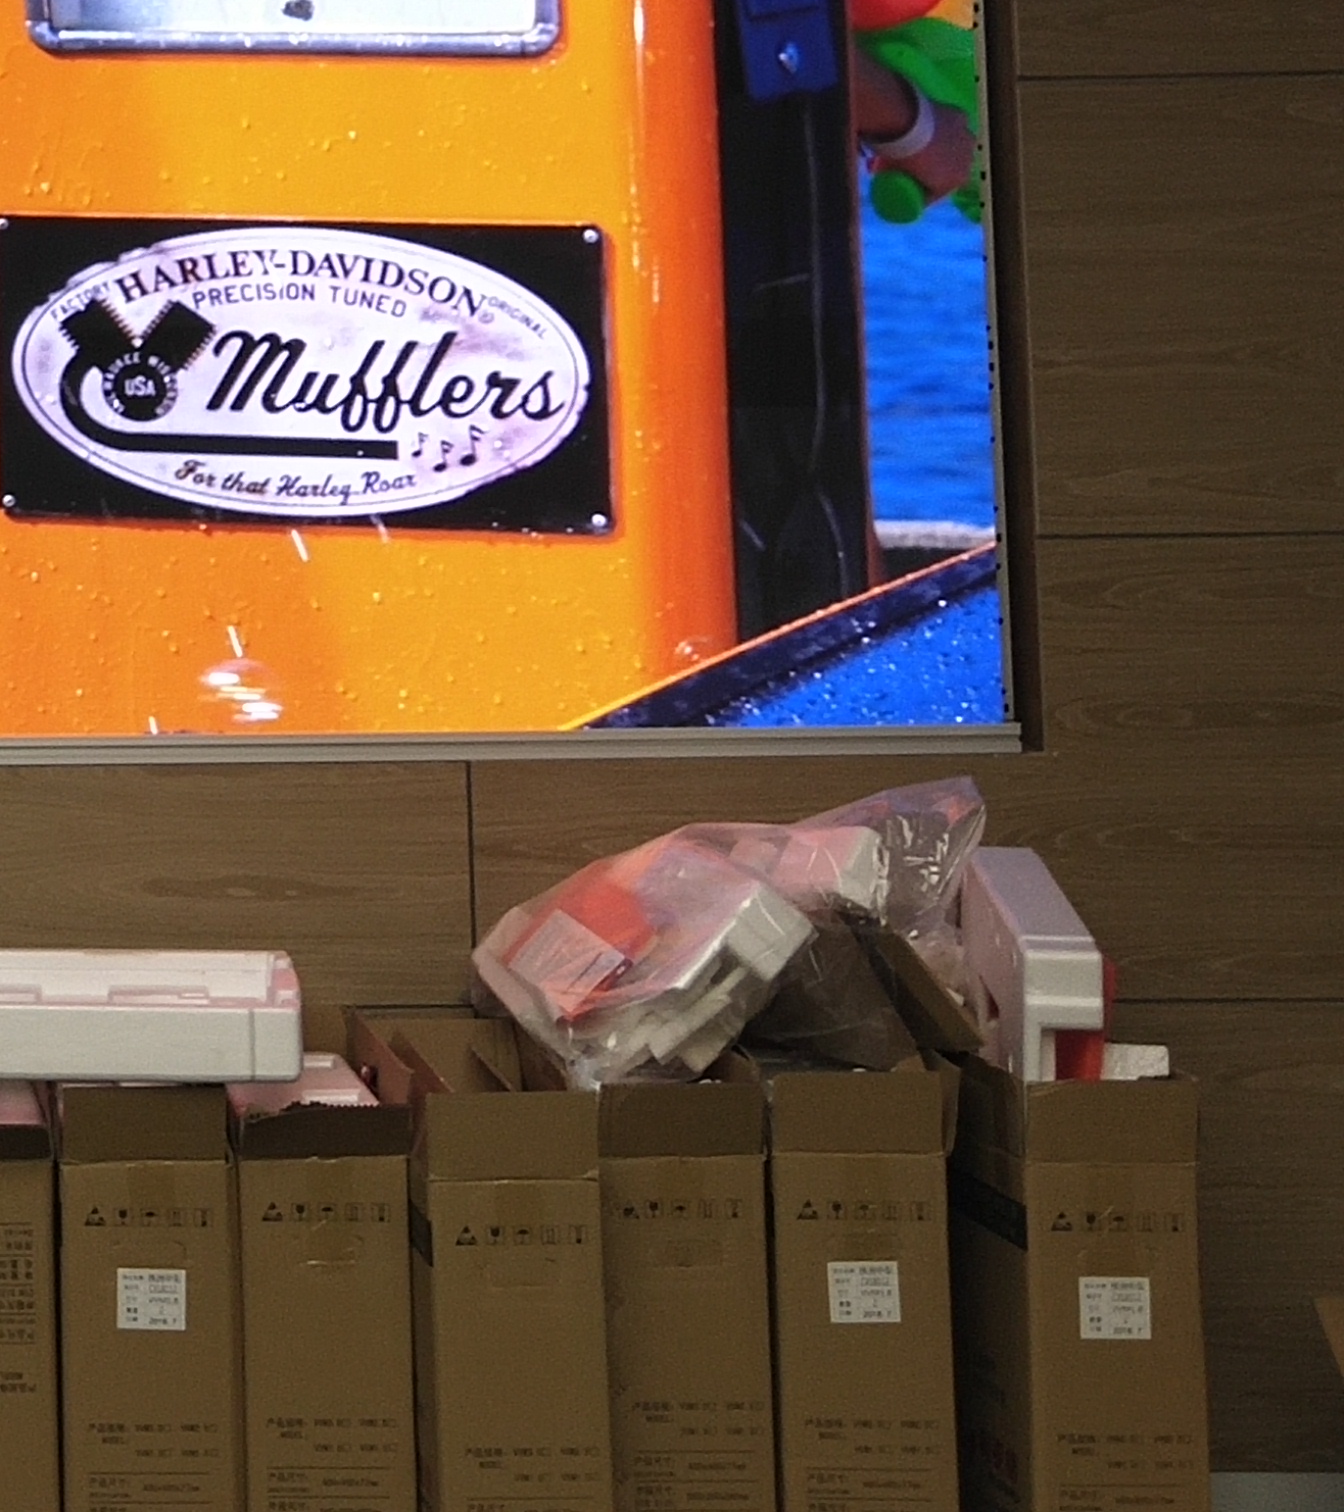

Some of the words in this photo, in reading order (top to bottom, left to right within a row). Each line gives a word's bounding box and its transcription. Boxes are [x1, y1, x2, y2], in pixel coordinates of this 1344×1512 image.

[115, 249, 487, 317] HARLEY-DAVIDSON
[192, 282, 315, 309] PRECISION
[328, 285, 407, 318] TUNED
[124, 374, 156, 397] USA
[206, 330, 565, 434] Mufflers
[175, 459, 216, 487] For
[221, 471, 272, 496] that
[275, 474, 353, 506] Harley
[360, 471, 418, 495] Roar
